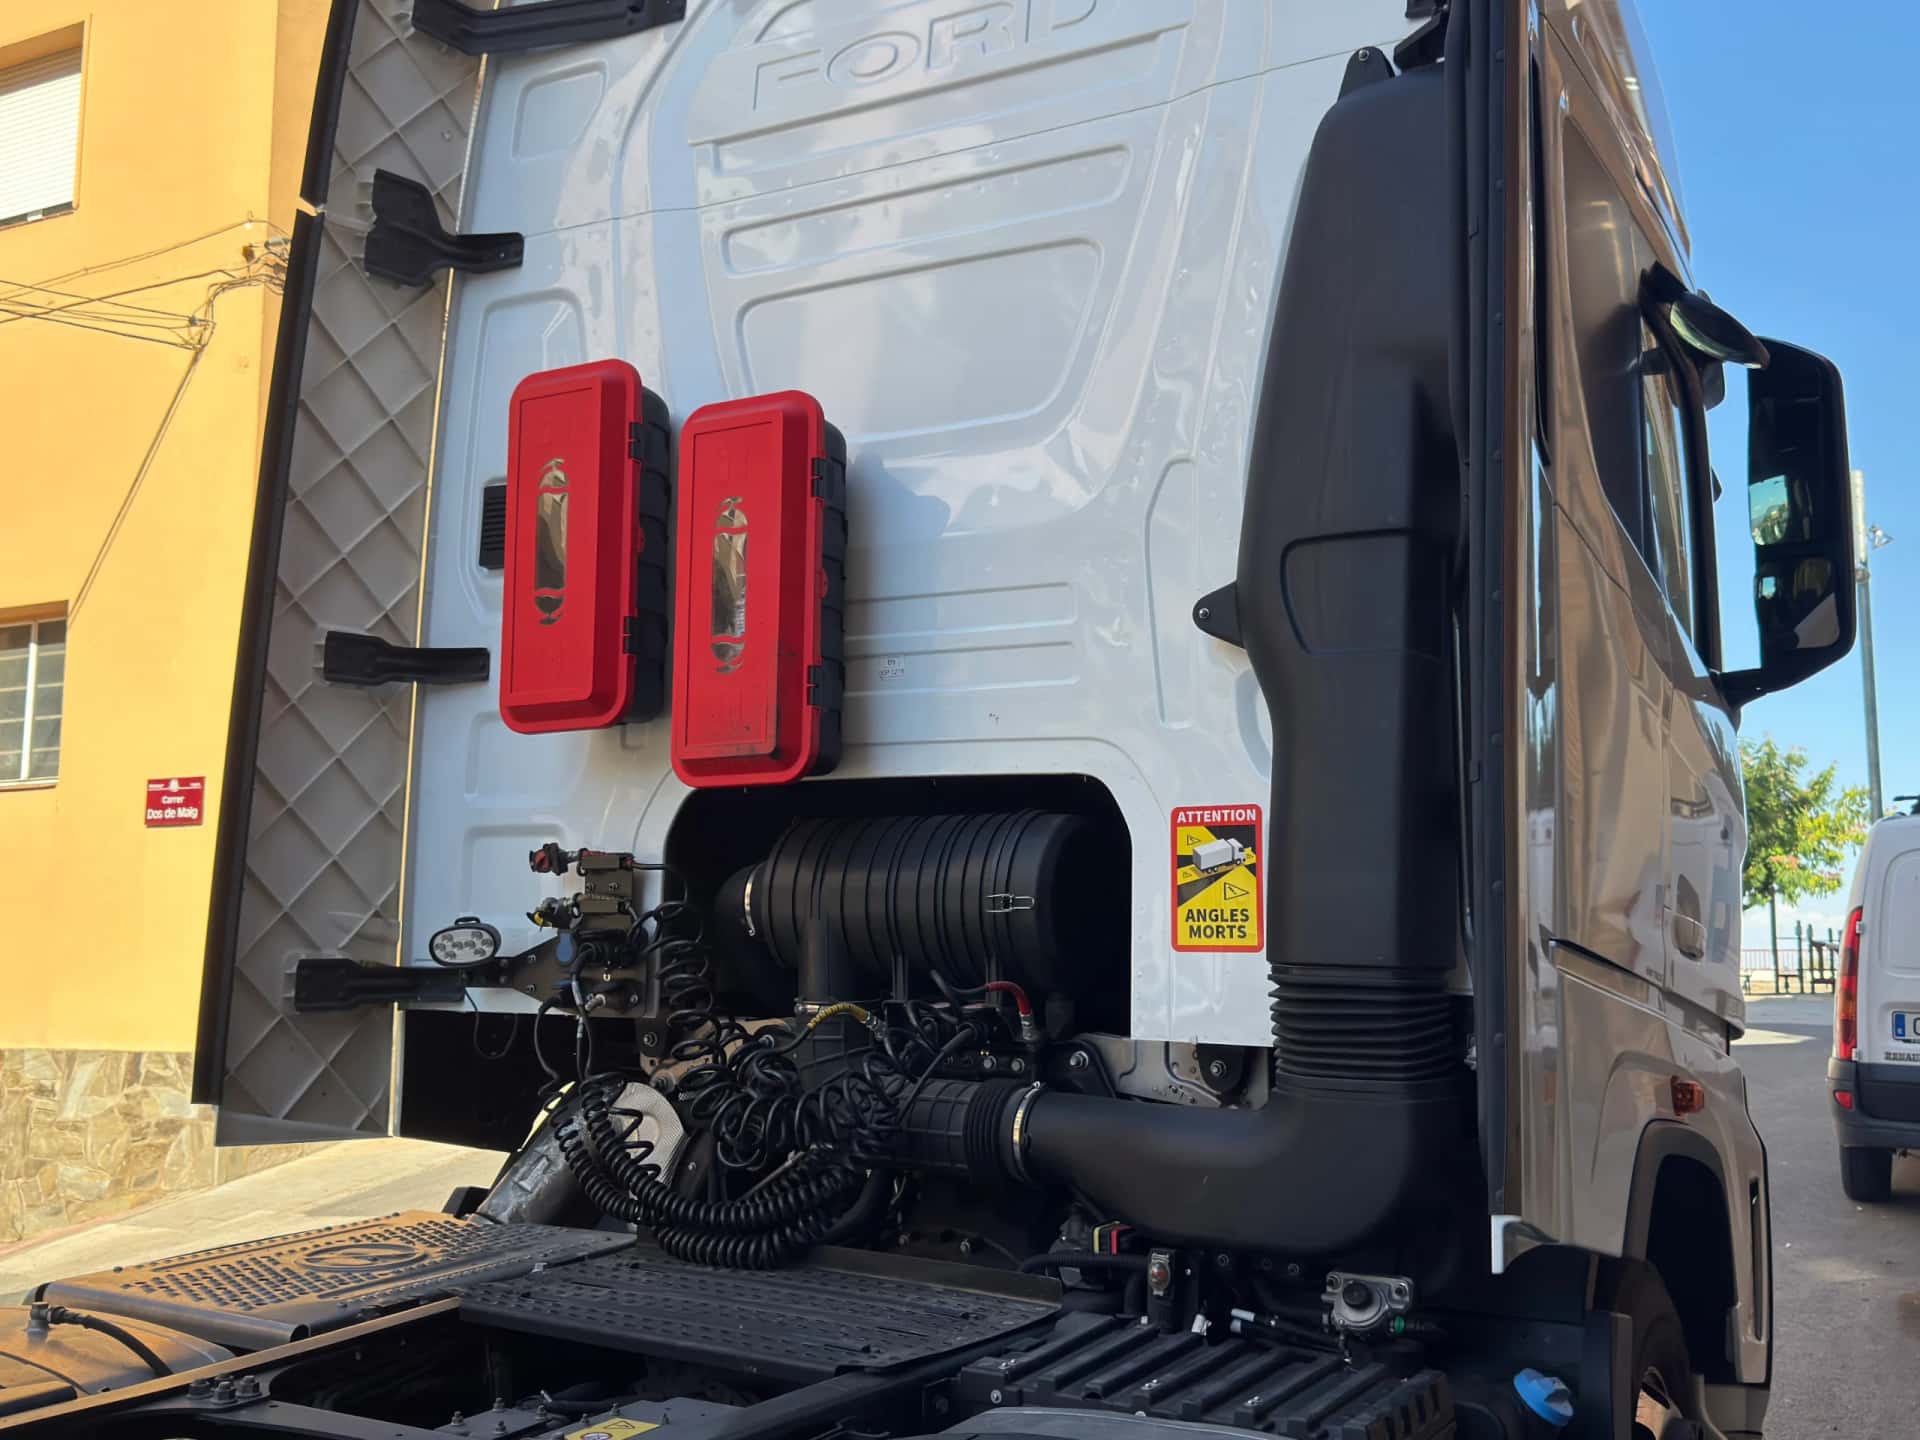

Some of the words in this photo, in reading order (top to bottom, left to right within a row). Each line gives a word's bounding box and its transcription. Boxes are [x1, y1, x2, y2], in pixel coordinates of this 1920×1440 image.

[752, 0, 1102, 112] FORD
[164, 807, 176, 818] de
[1177, 809, 1256, 823] ATTENTION
[1185, 908, 1250, 923] ANGLES
[1189, 925, 1248, 940] MORTS
